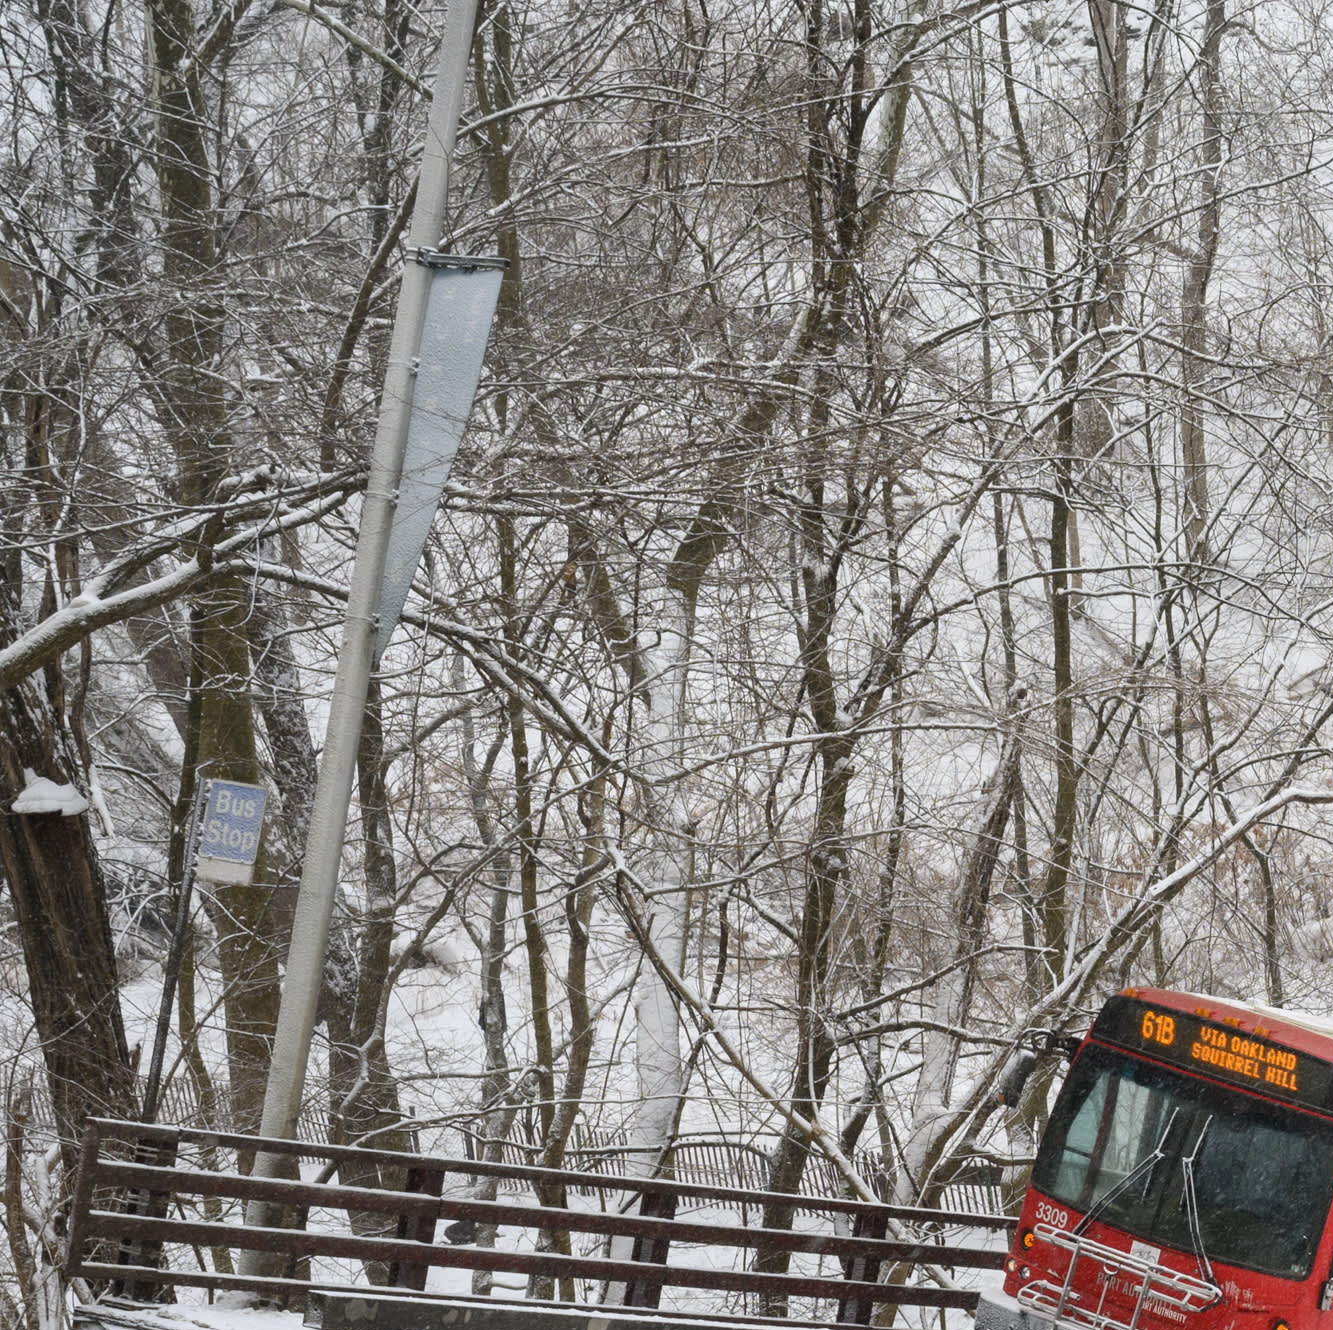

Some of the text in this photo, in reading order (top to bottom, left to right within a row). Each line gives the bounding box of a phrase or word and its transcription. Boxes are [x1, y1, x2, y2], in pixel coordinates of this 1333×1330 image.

[215, 789, 257, 818] Bus
[205, 819, 256, 854] Stop
[1142, 1010, 1175, 1046] 61B
[1200, 1026, 1298, 1071] VIA OAKLAND
[1192, 1042, 1298, 1091] SQUIRREL HILL
[1035, 1202, 1068, 1228] 3309
[1153, 1304, 1187, 1324] AUTHORITY
